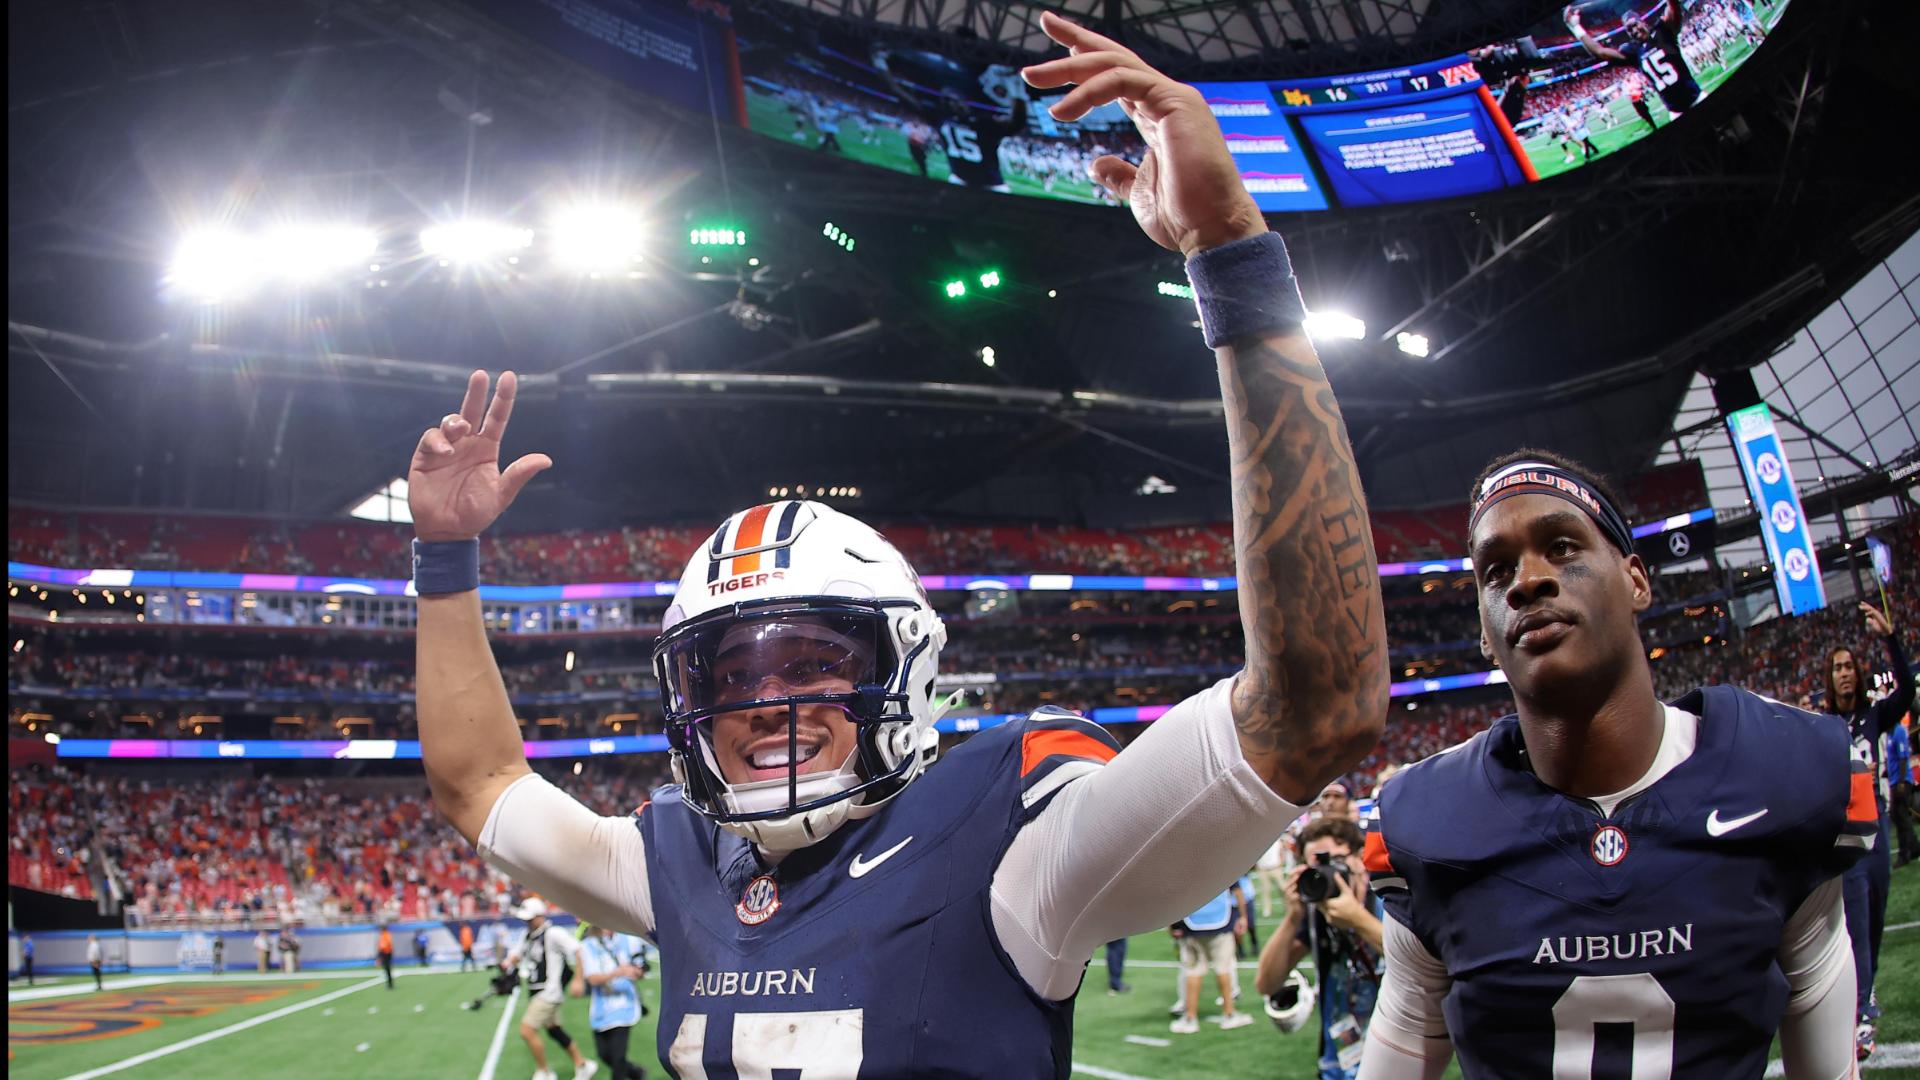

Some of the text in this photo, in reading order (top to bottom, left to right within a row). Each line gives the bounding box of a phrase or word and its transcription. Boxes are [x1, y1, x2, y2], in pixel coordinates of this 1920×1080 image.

[1409, 76, 1428, 91] 17
[1641, 49, 1678, 91] 15
[1325, 87, 1347, 102] 16
[941, 123, 983, 162] 15
[707, 571, 785, 597] TIGERS
[1594, 829, 1625, 863] SEC
[746, 879, 775, 912] SEC
[1532, 923, 1694, 965] AUBURN
[690, 967, 817, 997] AUBURN
